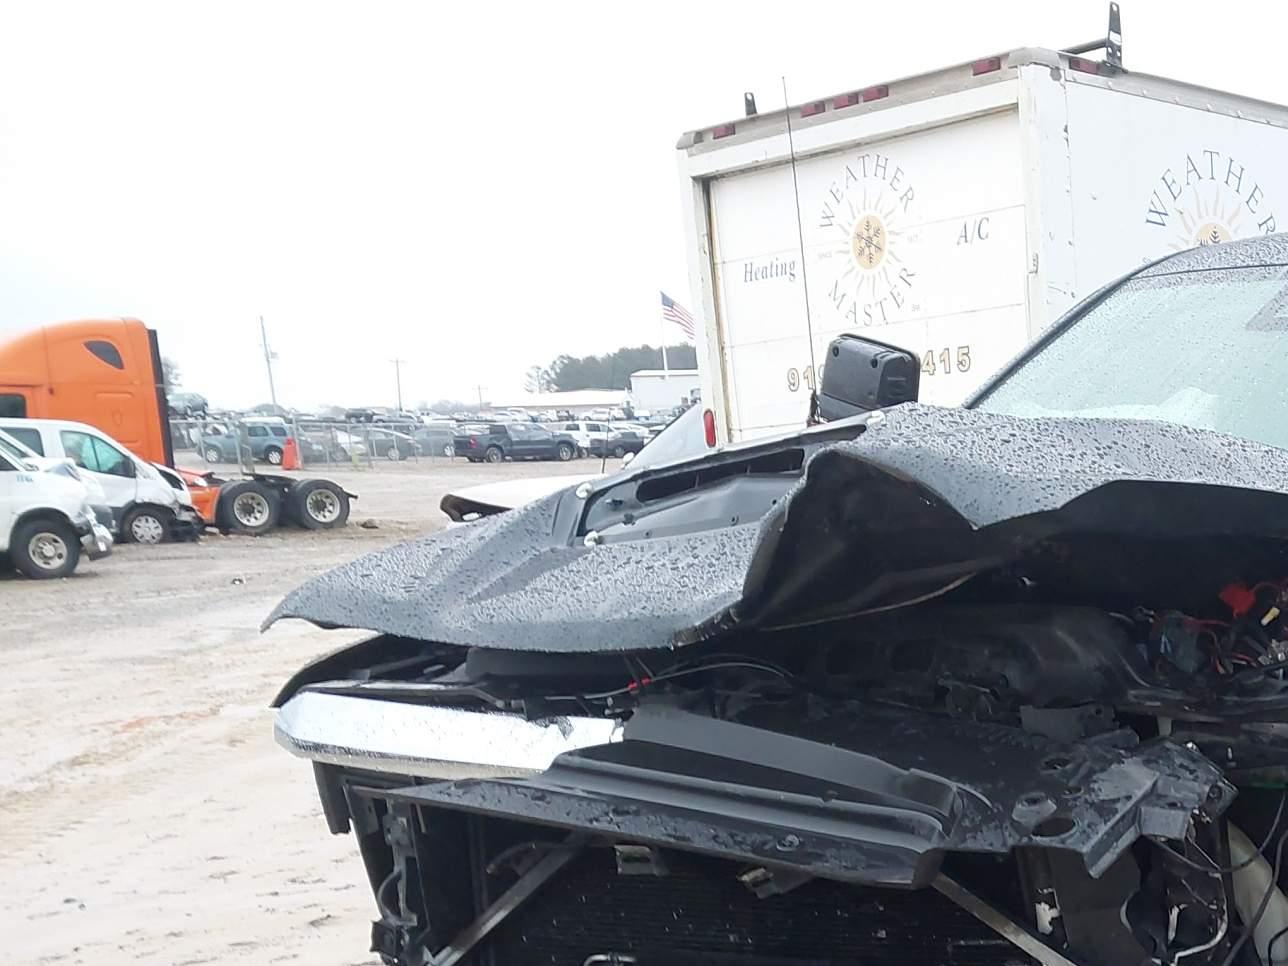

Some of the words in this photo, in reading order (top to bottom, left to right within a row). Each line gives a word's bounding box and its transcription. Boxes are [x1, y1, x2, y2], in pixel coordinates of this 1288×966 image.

[819, 153, 916, 229] WEATHER
[1145, 149, 1277, 235] WEATHER
[956, 217, 991, 246] A/C
[743, 259, 797, 284] Heating
[827, 266, 917, 327] MASTER
[921, 346, 971, 376] 415
